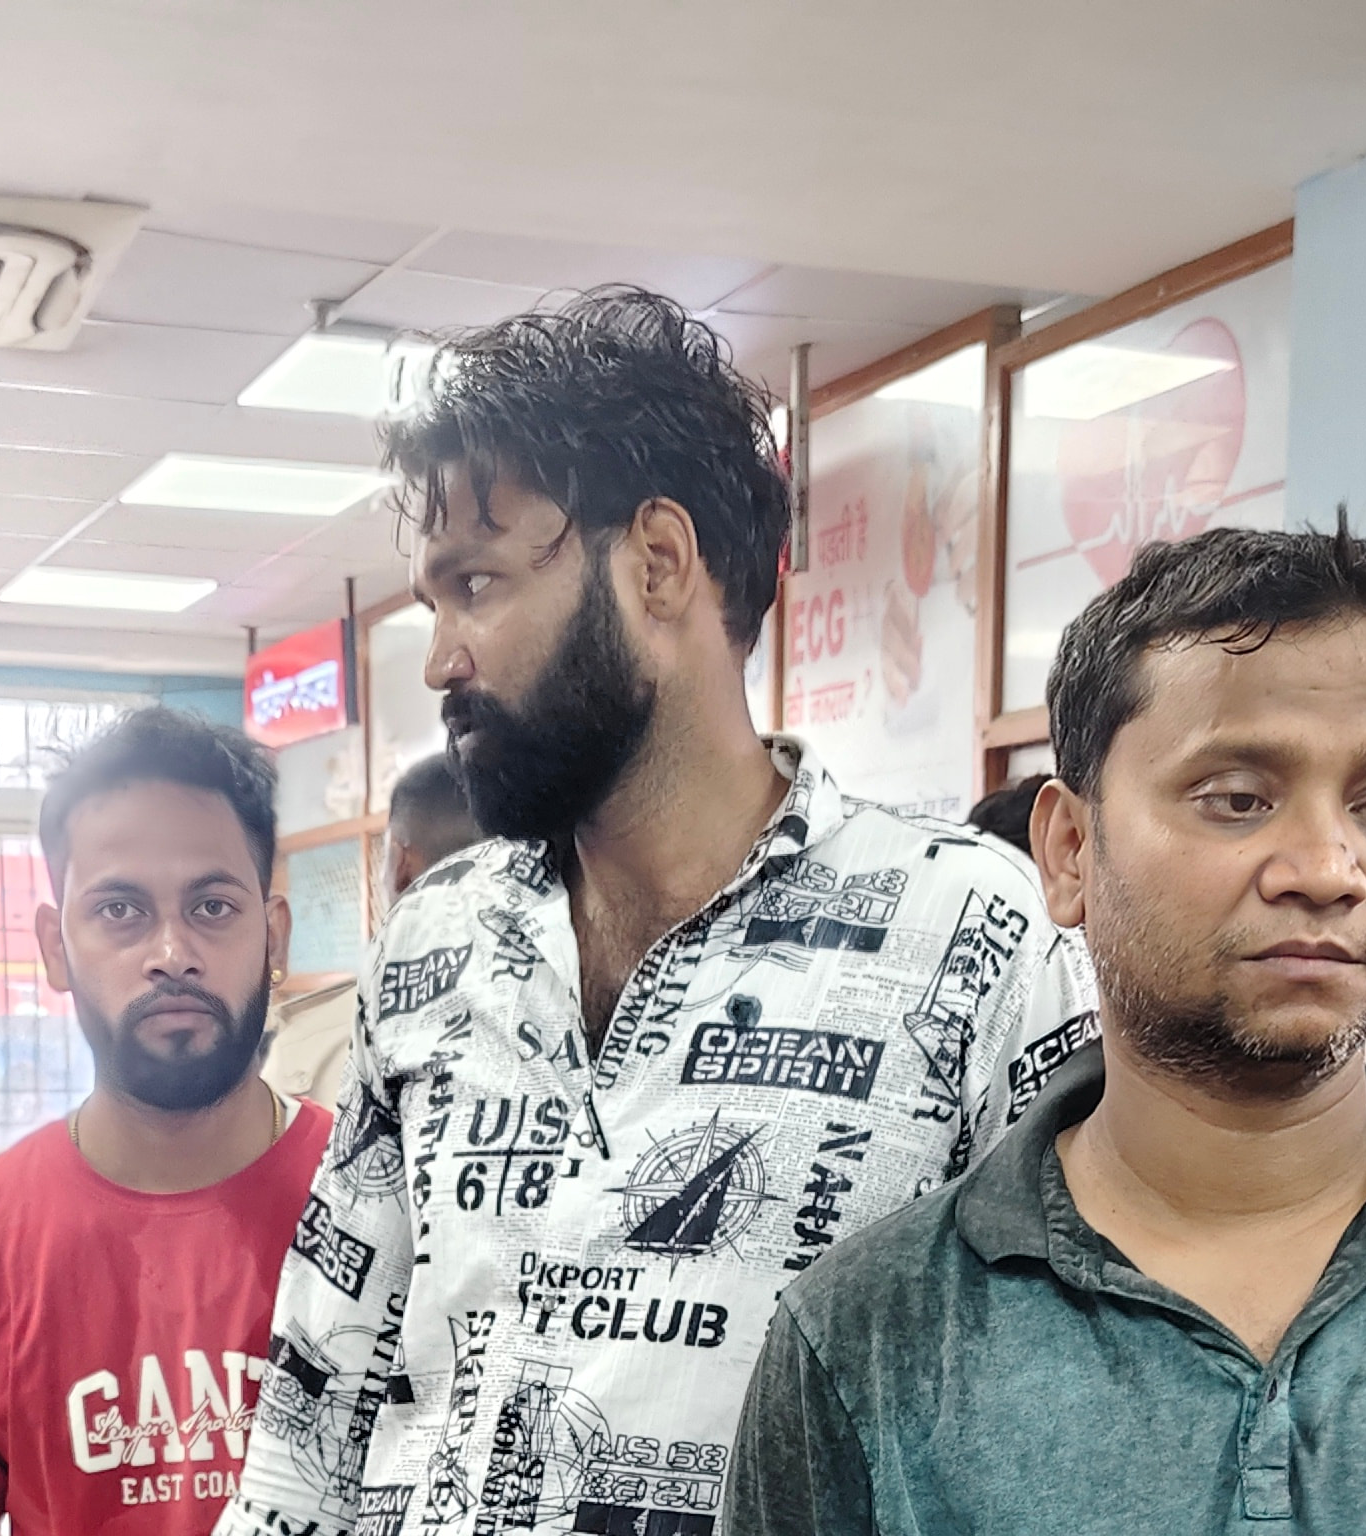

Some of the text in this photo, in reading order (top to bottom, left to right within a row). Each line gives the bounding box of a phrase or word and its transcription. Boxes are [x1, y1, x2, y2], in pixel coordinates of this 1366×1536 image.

[789, 588, 845, 668] ECG
[700, 1027, 874, 1067] OCEAN
[692, 1055, 866, 1091] SPIRIT
[571, 1295, 728, 1348] CLUB
[88, 1405, 176, 1464] League
[121, 1474, 184, 1505] EAST
